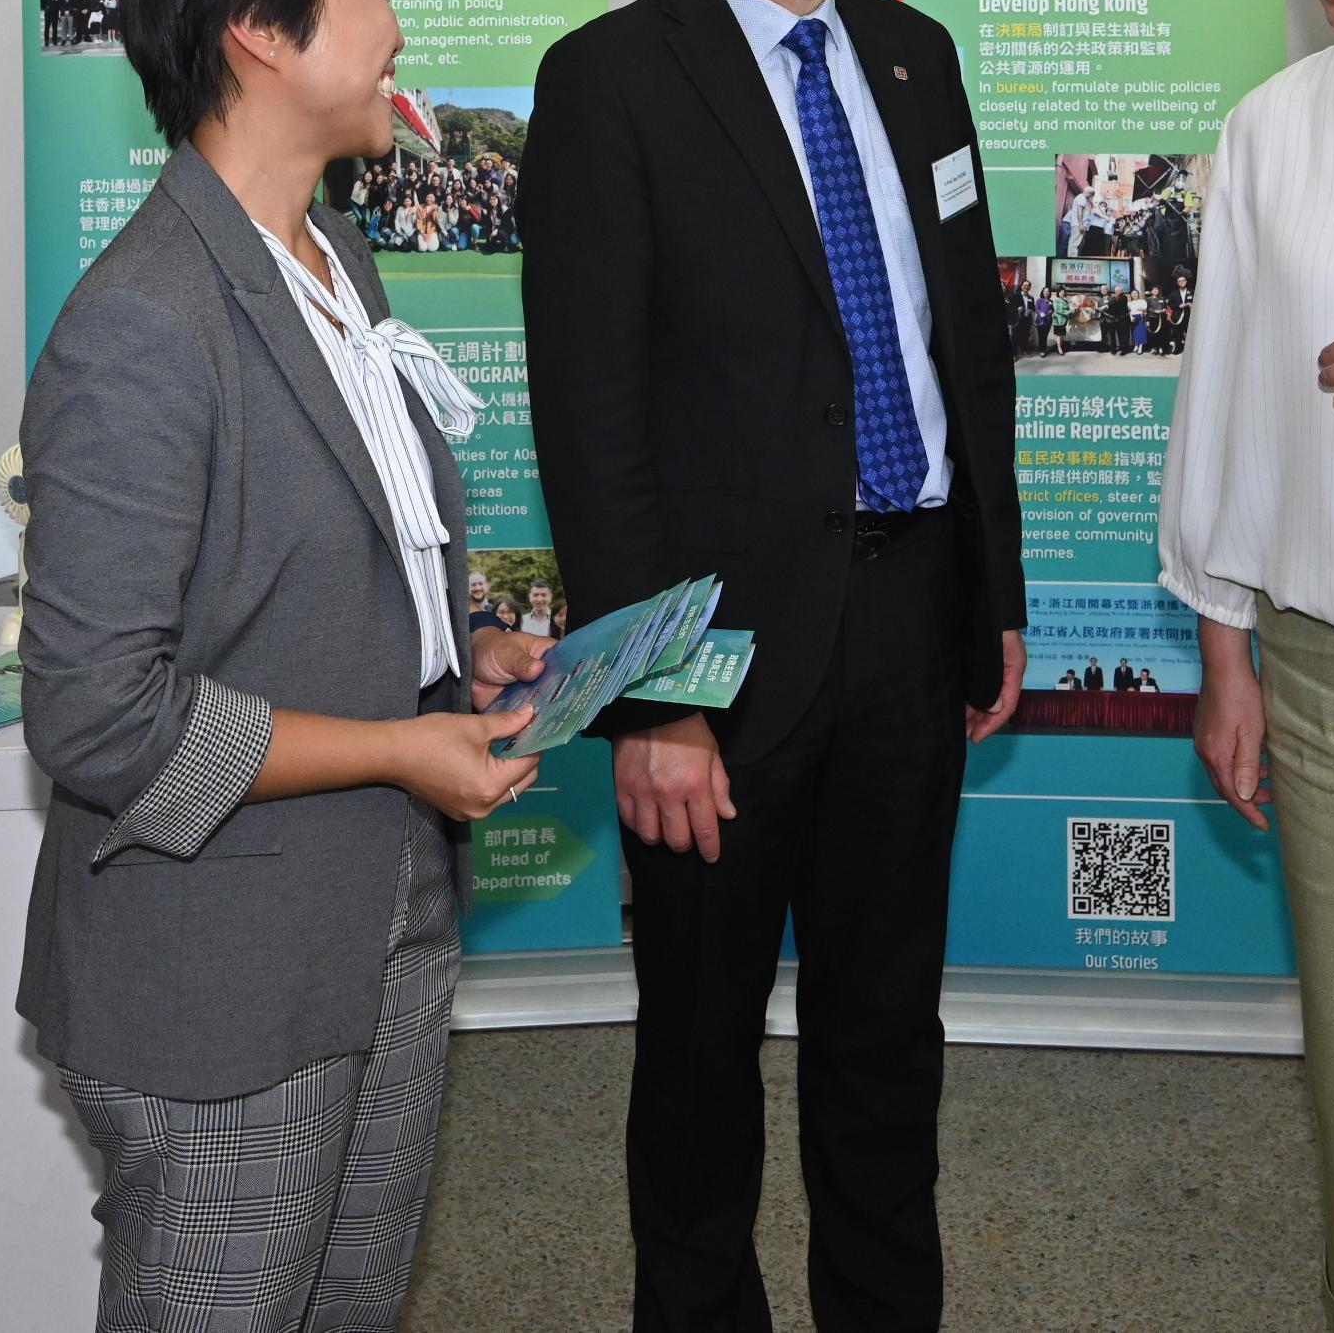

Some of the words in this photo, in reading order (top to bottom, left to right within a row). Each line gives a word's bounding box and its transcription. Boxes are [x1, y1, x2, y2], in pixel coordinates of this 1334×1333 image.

[979, 81, 990, 93] In
[997, 81, 1048, 94] bureau,
[1052, 81, 1119, 93] formulate
[1125, 81, 1165, 95] public
[1170, 81, 1220, 95] policies
[484, 828, 556, 847] 部門首長
[491, 852, 528, 866] Head
[535, 851, 550, 864] of
[1075, 928, 1167, 946] 我們的故事
[1086, 955, 1107, 968] Our
[1112, 955, 1158, 969] Stories
